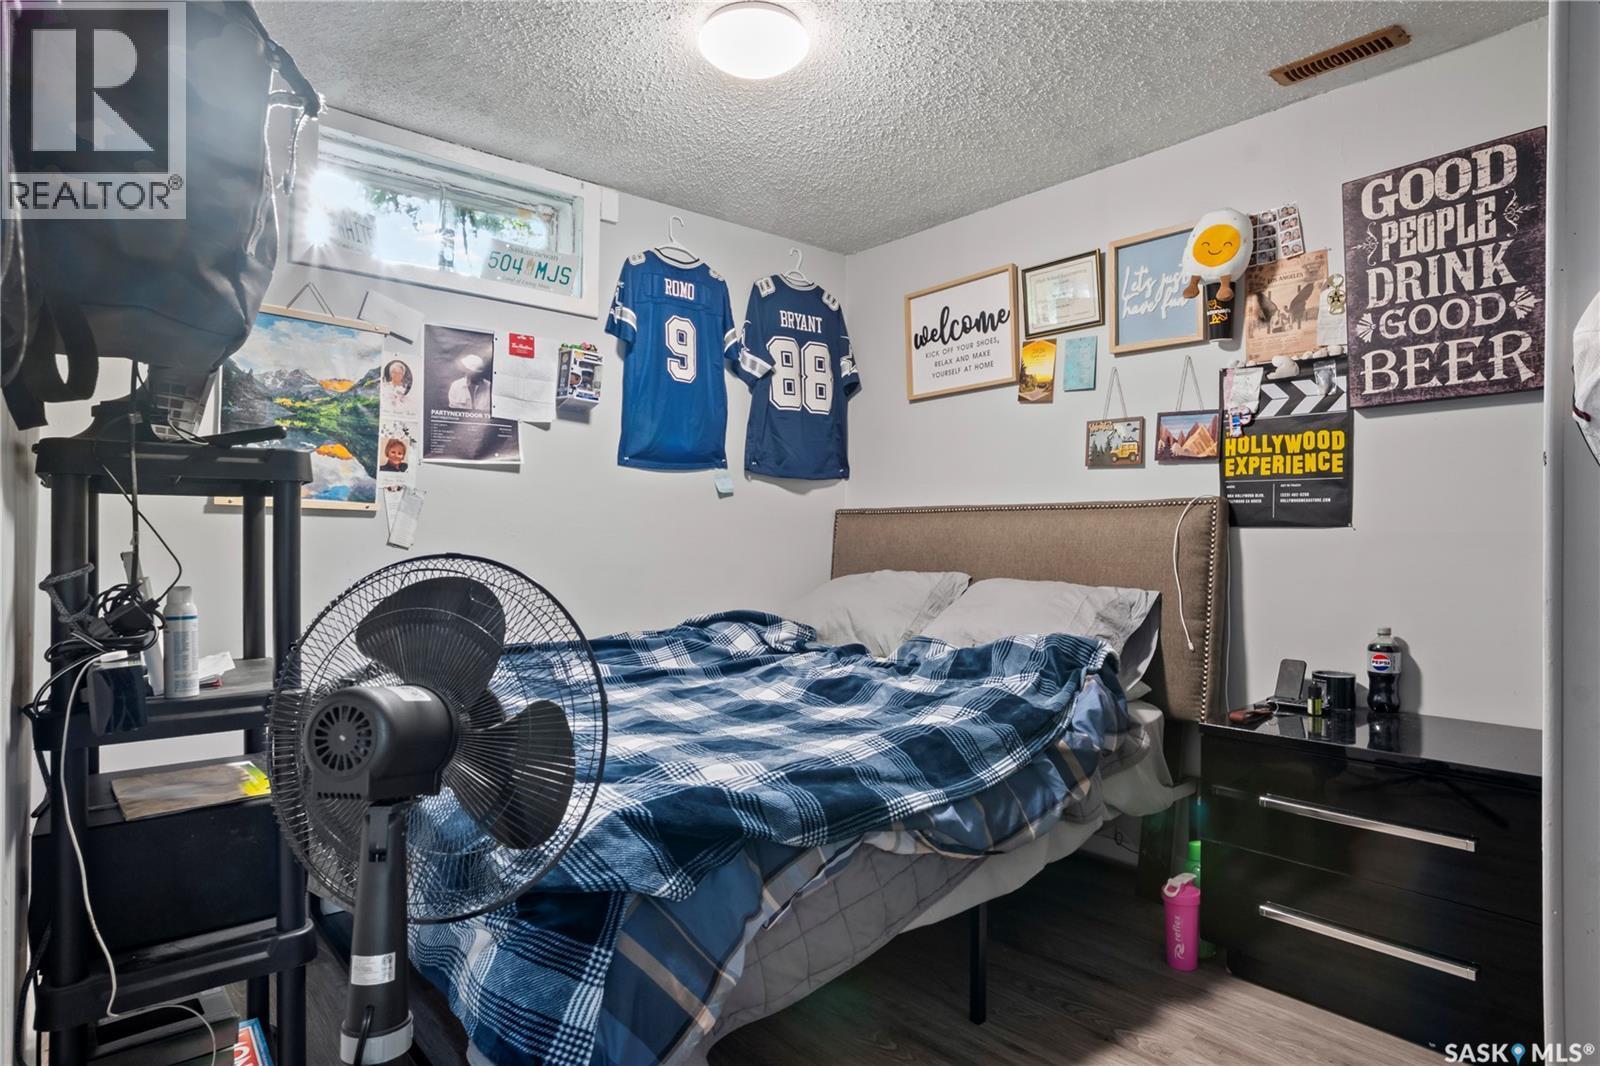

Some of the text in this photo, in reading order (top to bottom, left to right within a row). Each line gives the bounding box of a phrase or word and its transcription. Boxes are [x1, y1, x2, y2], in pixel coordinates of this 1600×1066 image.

[1361, 143, 1518, 220] GOOD
[1381, 195, 1496, 262] PEOPLE
[488, 250, 572, 285] 504 MJS
[1366, 239, 1517, 309] DRINK
[664, 278, 695, 300] ROMO
[779, 310, 823, 334] BRYANT
[914, 306, 1010, 350] welcome
[1379, 292, 1506, 339] GOOD
[665, 315, 697, 384] 9
[925, 337, 1000, 359] KICK OFF YOUR SHOES,
[934, 349, 991, 368] RELAX AND MAKE
[1360, 330, 1535, 395] BEER
[766, 335, 834, 415] 88
[932, 360, 994, 379] YOURSELF AT HOME
[1225, 430, 1345, 457] HOLLYWOOD
[1225, 451, 1344, 477] EXPERIENCE
